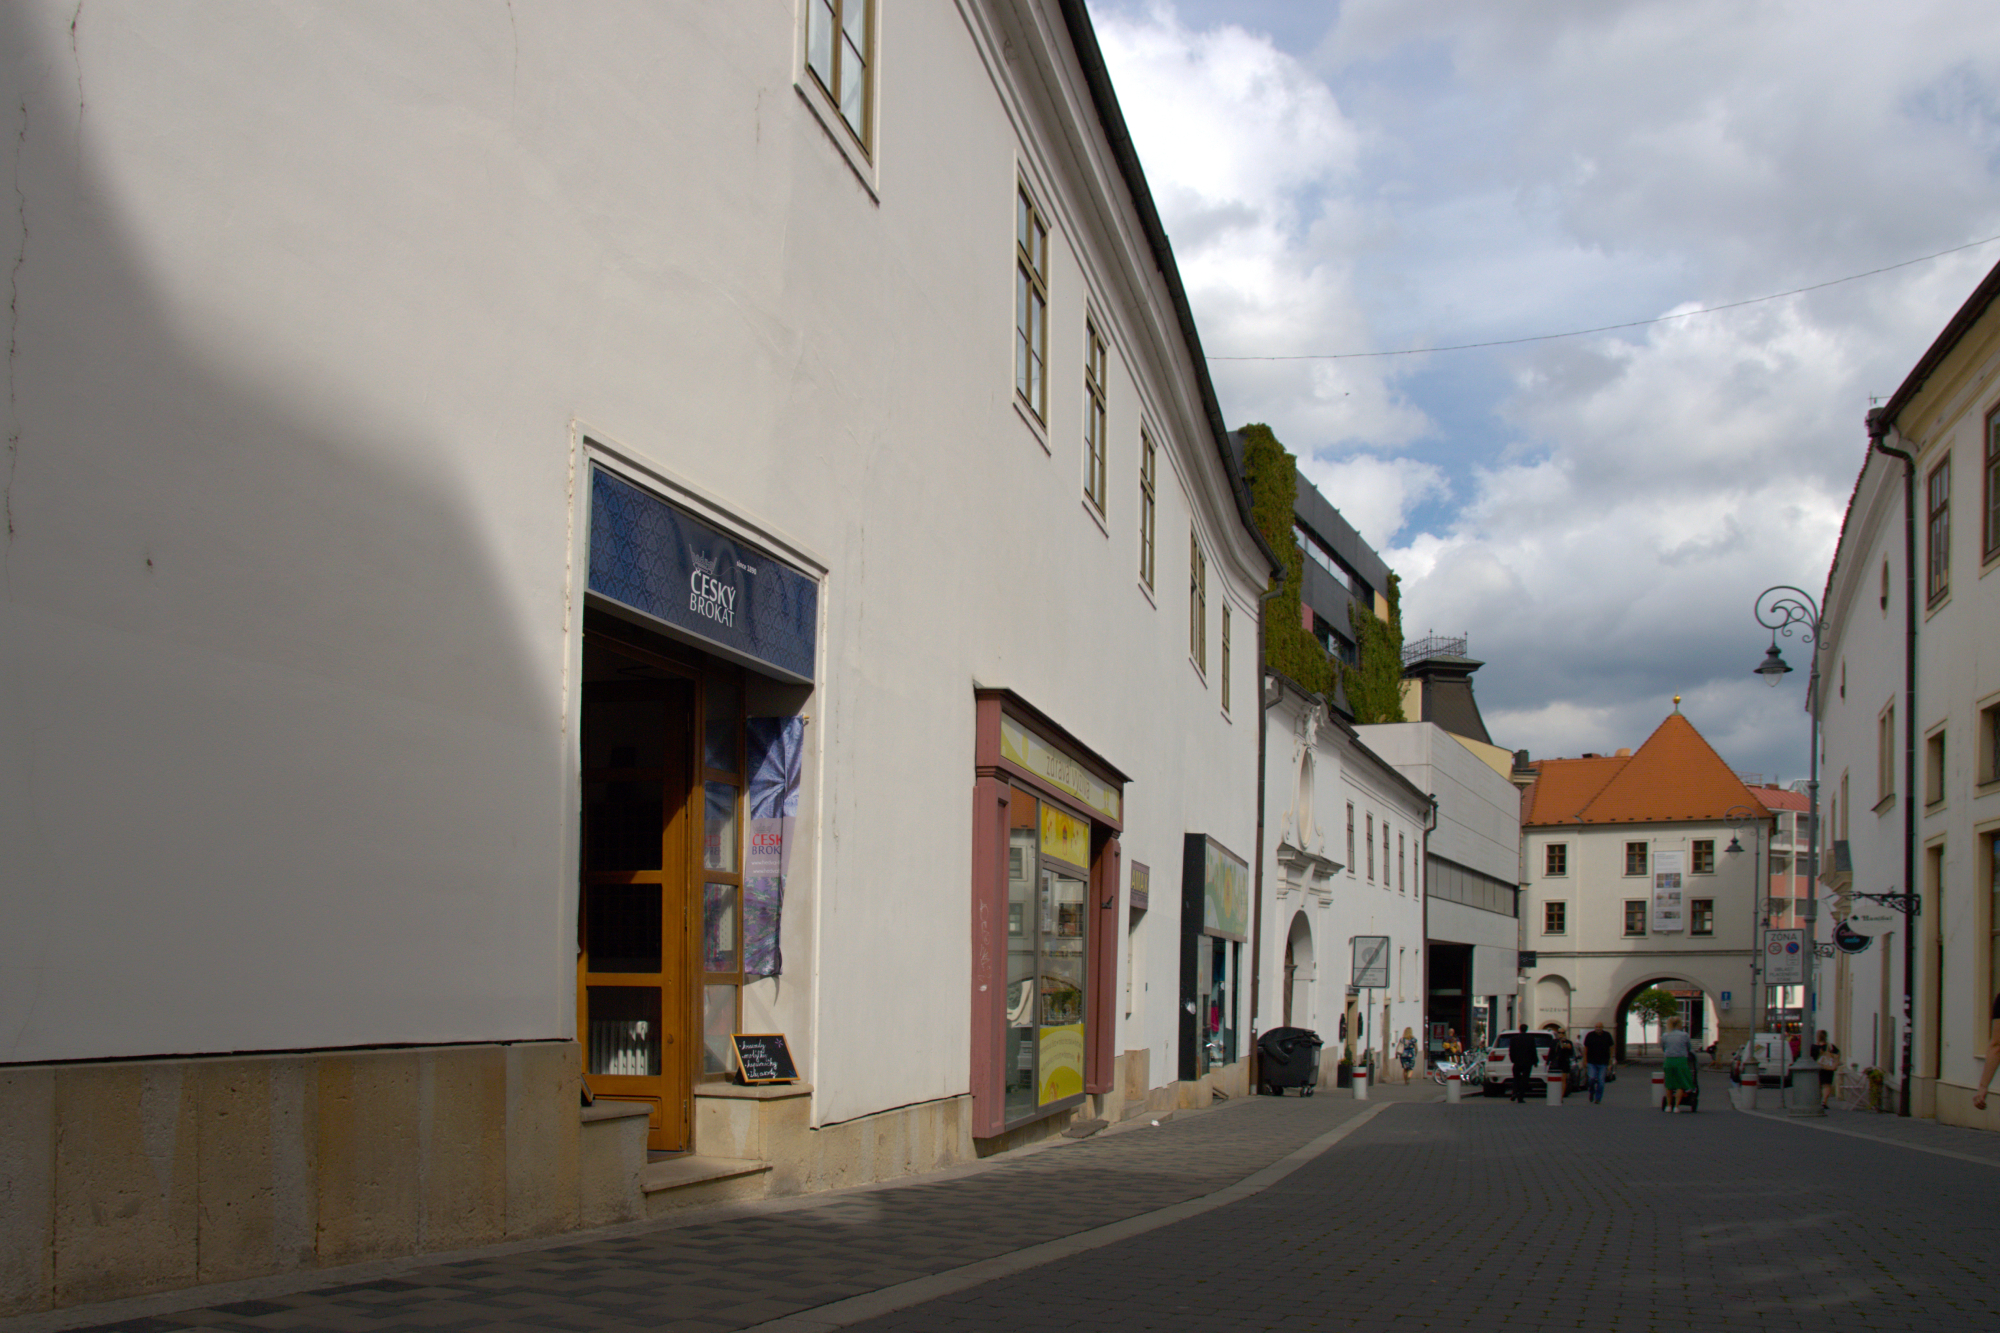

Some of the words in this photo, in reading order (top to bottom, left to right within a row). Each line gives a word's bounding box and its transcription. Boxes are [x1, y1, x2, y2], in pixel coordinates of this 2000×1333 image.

[691, 569, 736, 610] ČESKÝ
[690, 592, 735, 627] BROKÁT
[1770, 931, 1798, 942] ZÓNA
